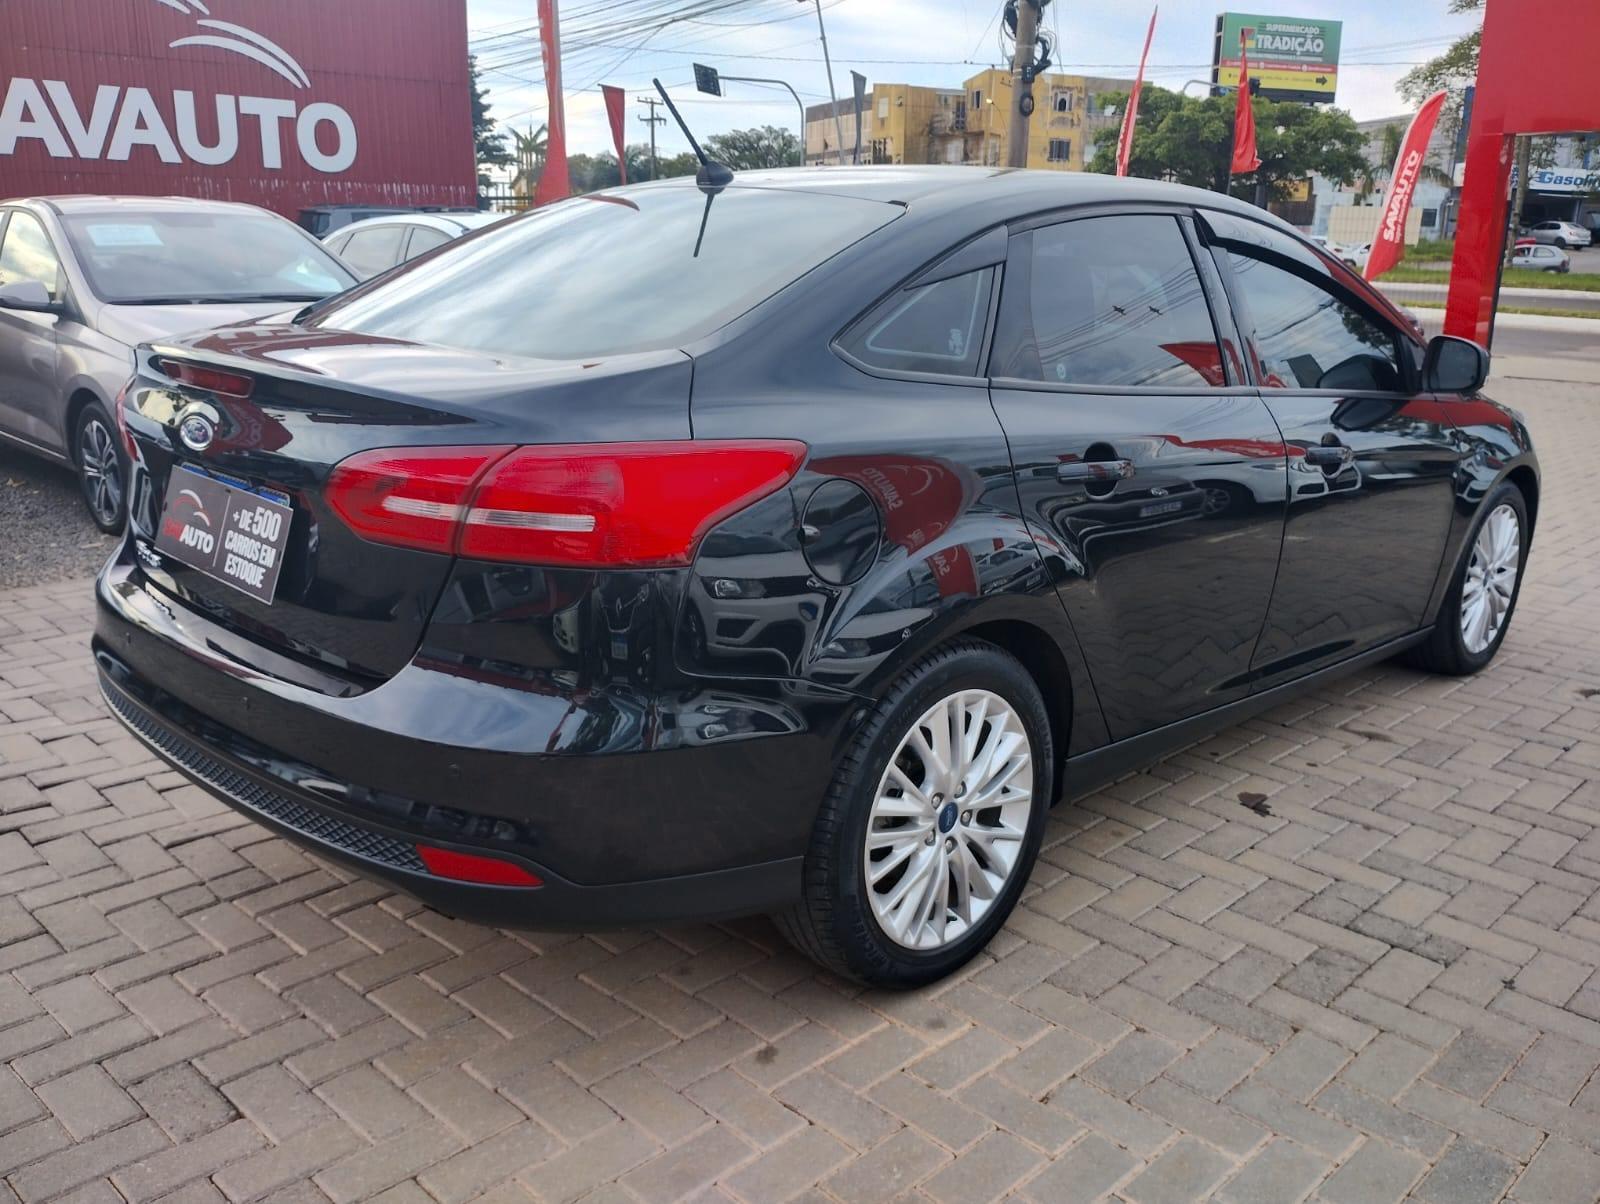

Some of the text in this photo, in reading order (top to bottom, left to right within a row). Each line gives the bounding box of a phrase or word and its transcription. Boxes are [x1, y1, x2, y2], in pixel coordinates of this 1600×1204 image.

[1256, 34, 1324, 55] TRADIÇÃO
[1383, 149, 1420, 242] SAVAUTO
[252, 506, 282, 542] 500
[224, 529, 277, 568] CARROS EM
[224, 553, 266, 589] ESTOQUE
